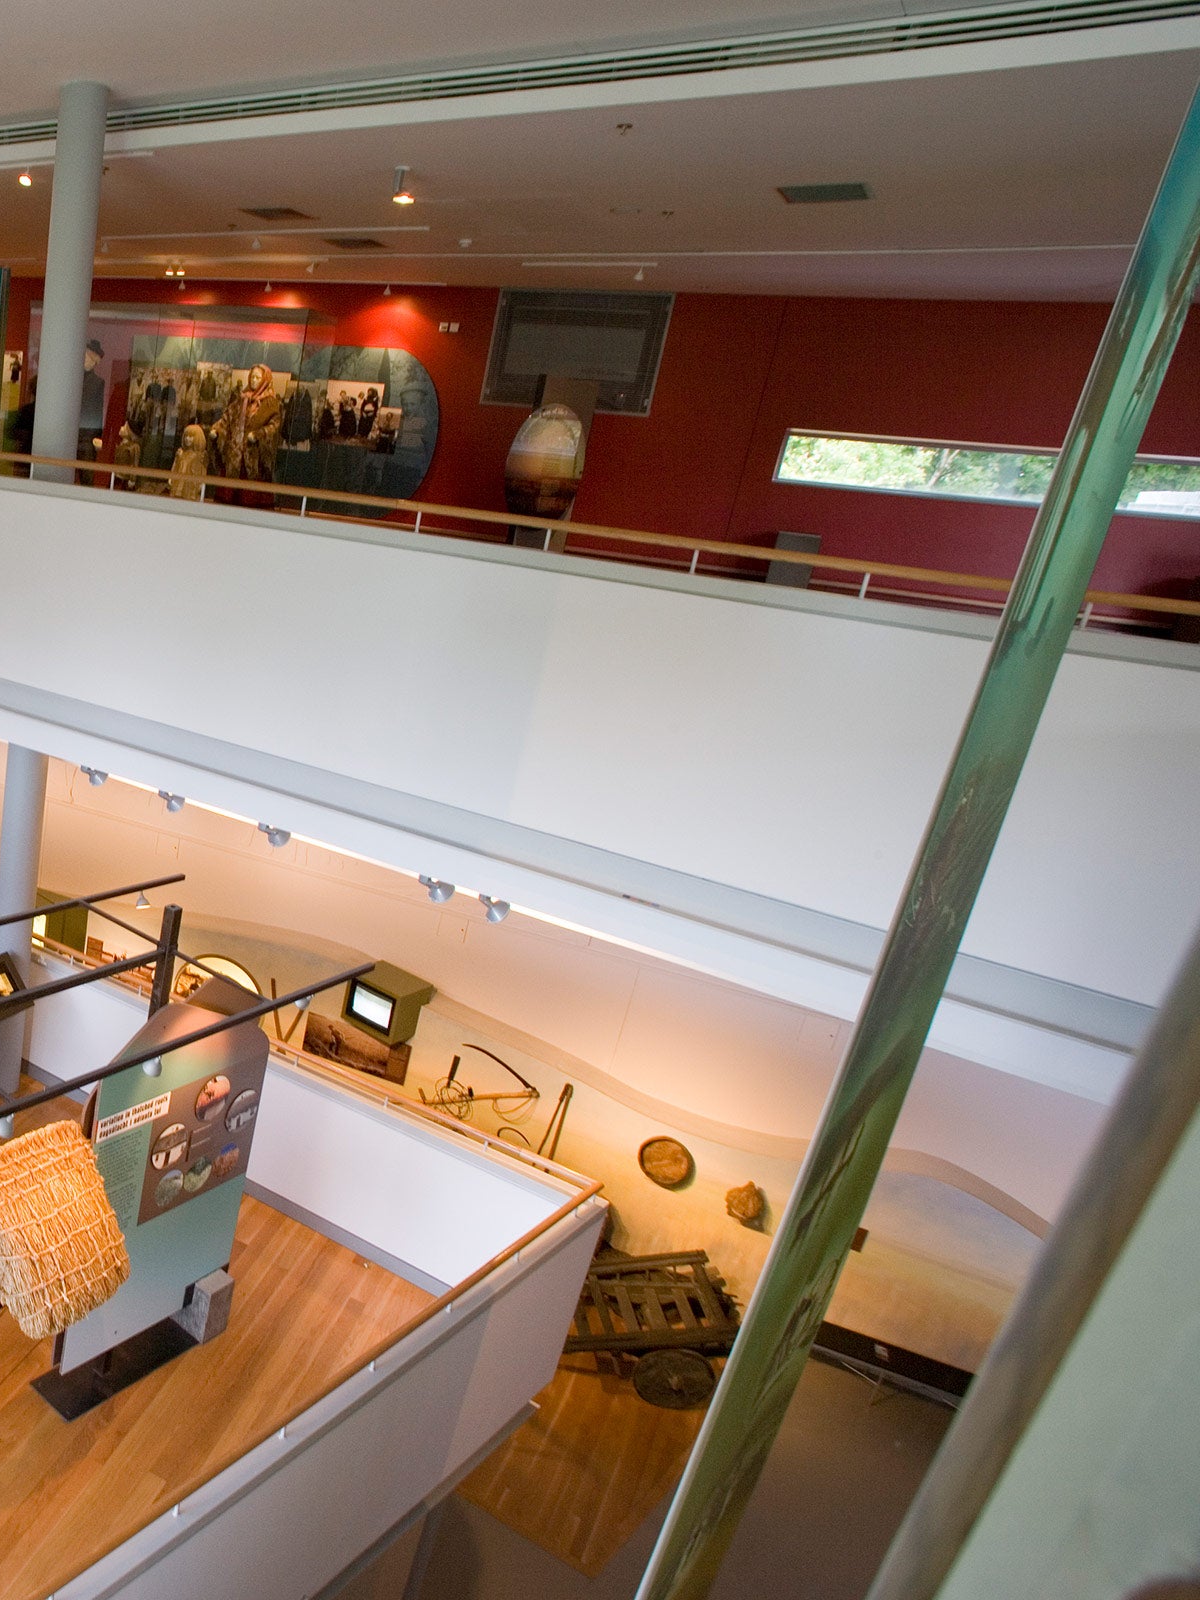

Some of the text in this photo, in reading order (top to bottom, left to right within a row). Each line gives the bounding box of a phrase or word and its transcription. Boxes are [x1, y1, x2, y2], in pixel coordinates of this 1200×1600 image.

[100, 1095, 168, 1129] variation in thatched roofs
